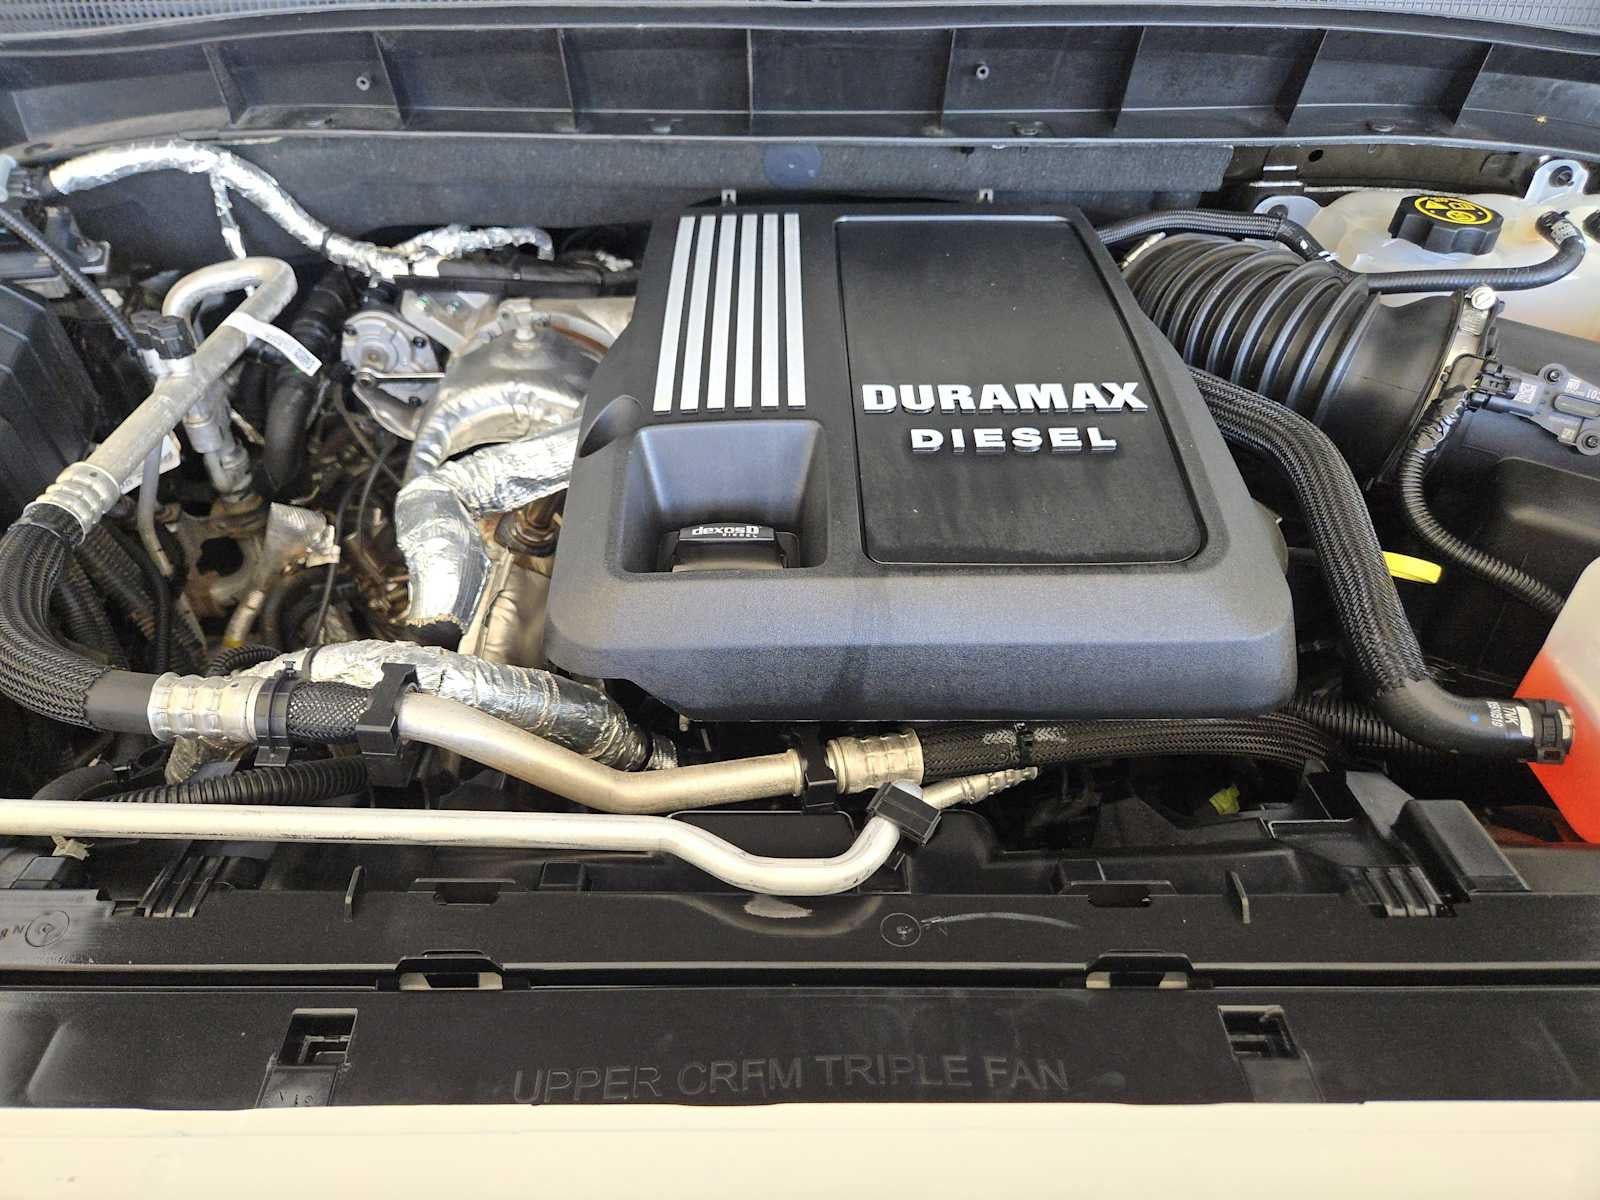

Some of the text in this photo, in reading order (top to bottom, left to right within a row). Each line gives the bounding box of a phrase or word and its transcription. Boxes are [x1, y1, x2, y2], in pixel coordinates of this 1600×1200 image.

[861, 382, 1148, 413] DURAMAX
[910, 427, 1118, 451] DIESEL
[513, 1065, 663, 1104] UPPER
[815, 1054, 973, 1088] TRIPLE
[983, 1055, 1069, 1091] FAN
